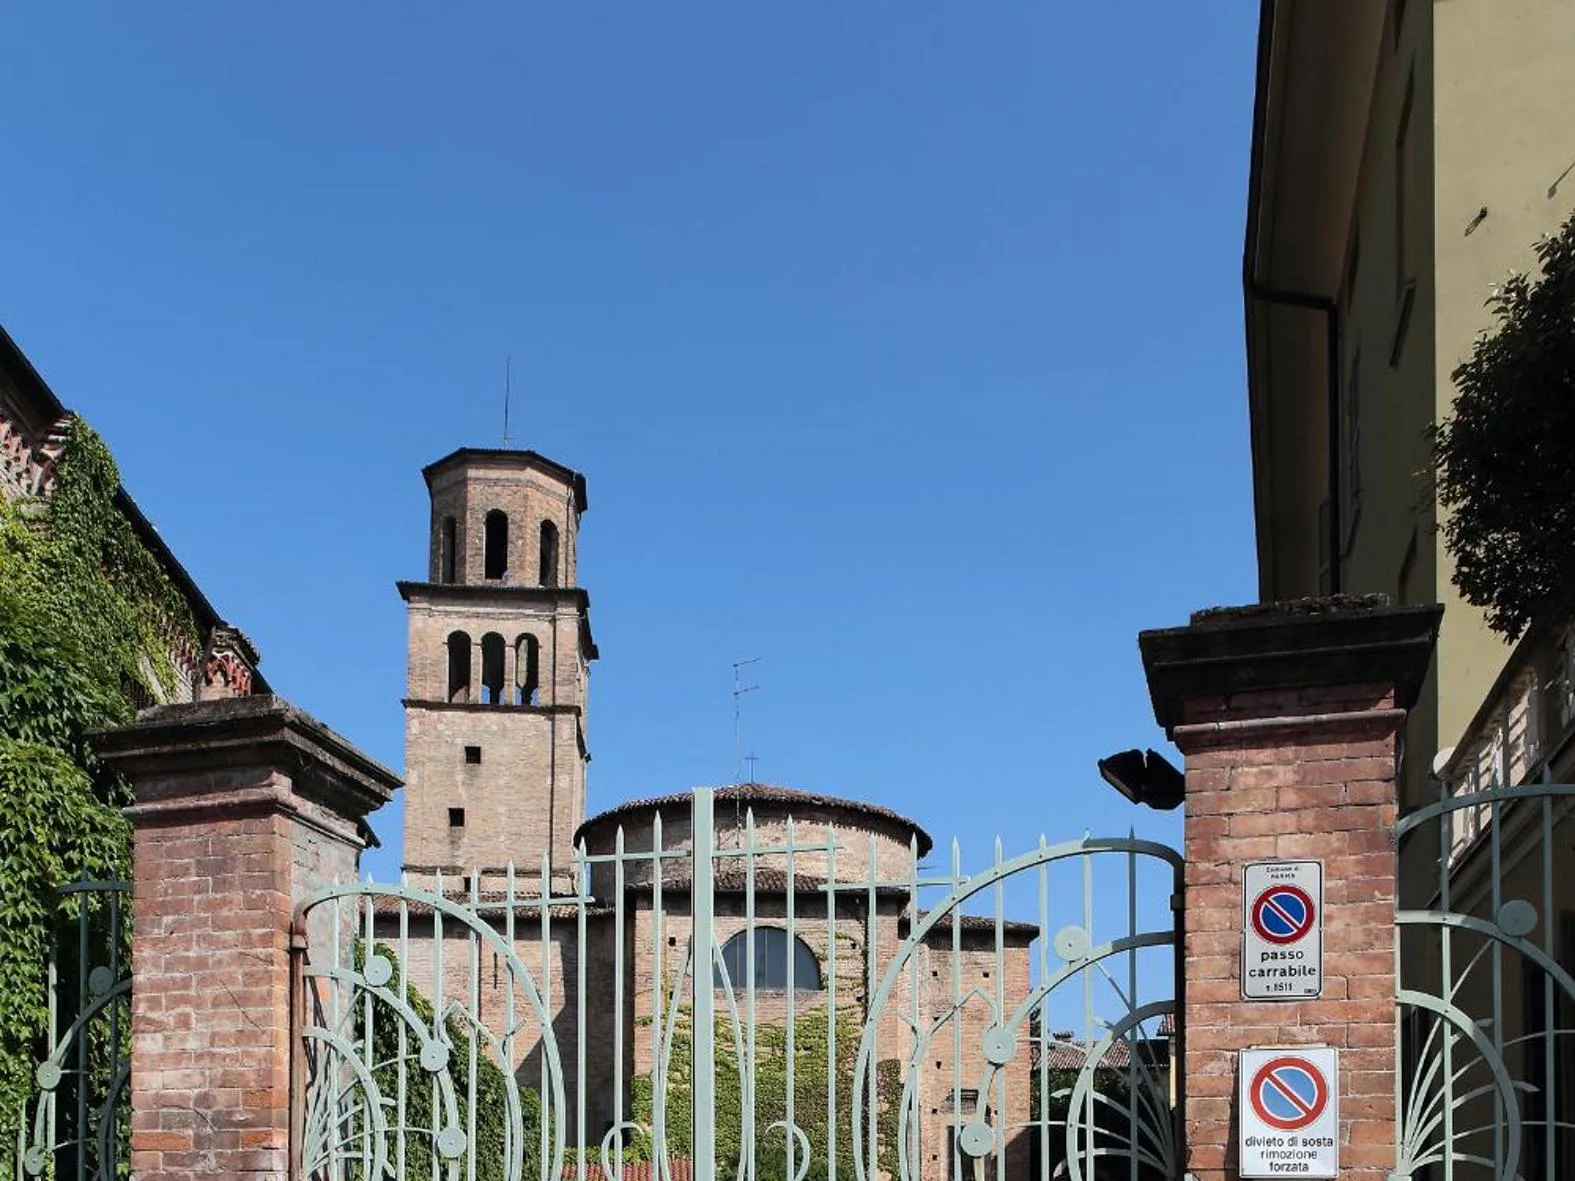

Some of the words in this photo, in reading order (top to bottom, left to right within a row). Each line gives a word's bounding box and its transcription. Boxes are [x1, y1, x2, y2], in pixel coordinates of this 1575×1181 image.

[1261, 951, 1304, 962] passo
[1248, 965, 1316, 977] carrabile
[1245, 1136, 1284, 1147] divieto
[1287, 1136, 1298, 1147] di
[1302, 1137, 1333, 1147] sosta
[1260, 1149, 1318, 1159] rimozione
[1269, 1162, 1309, 1172] forzata
